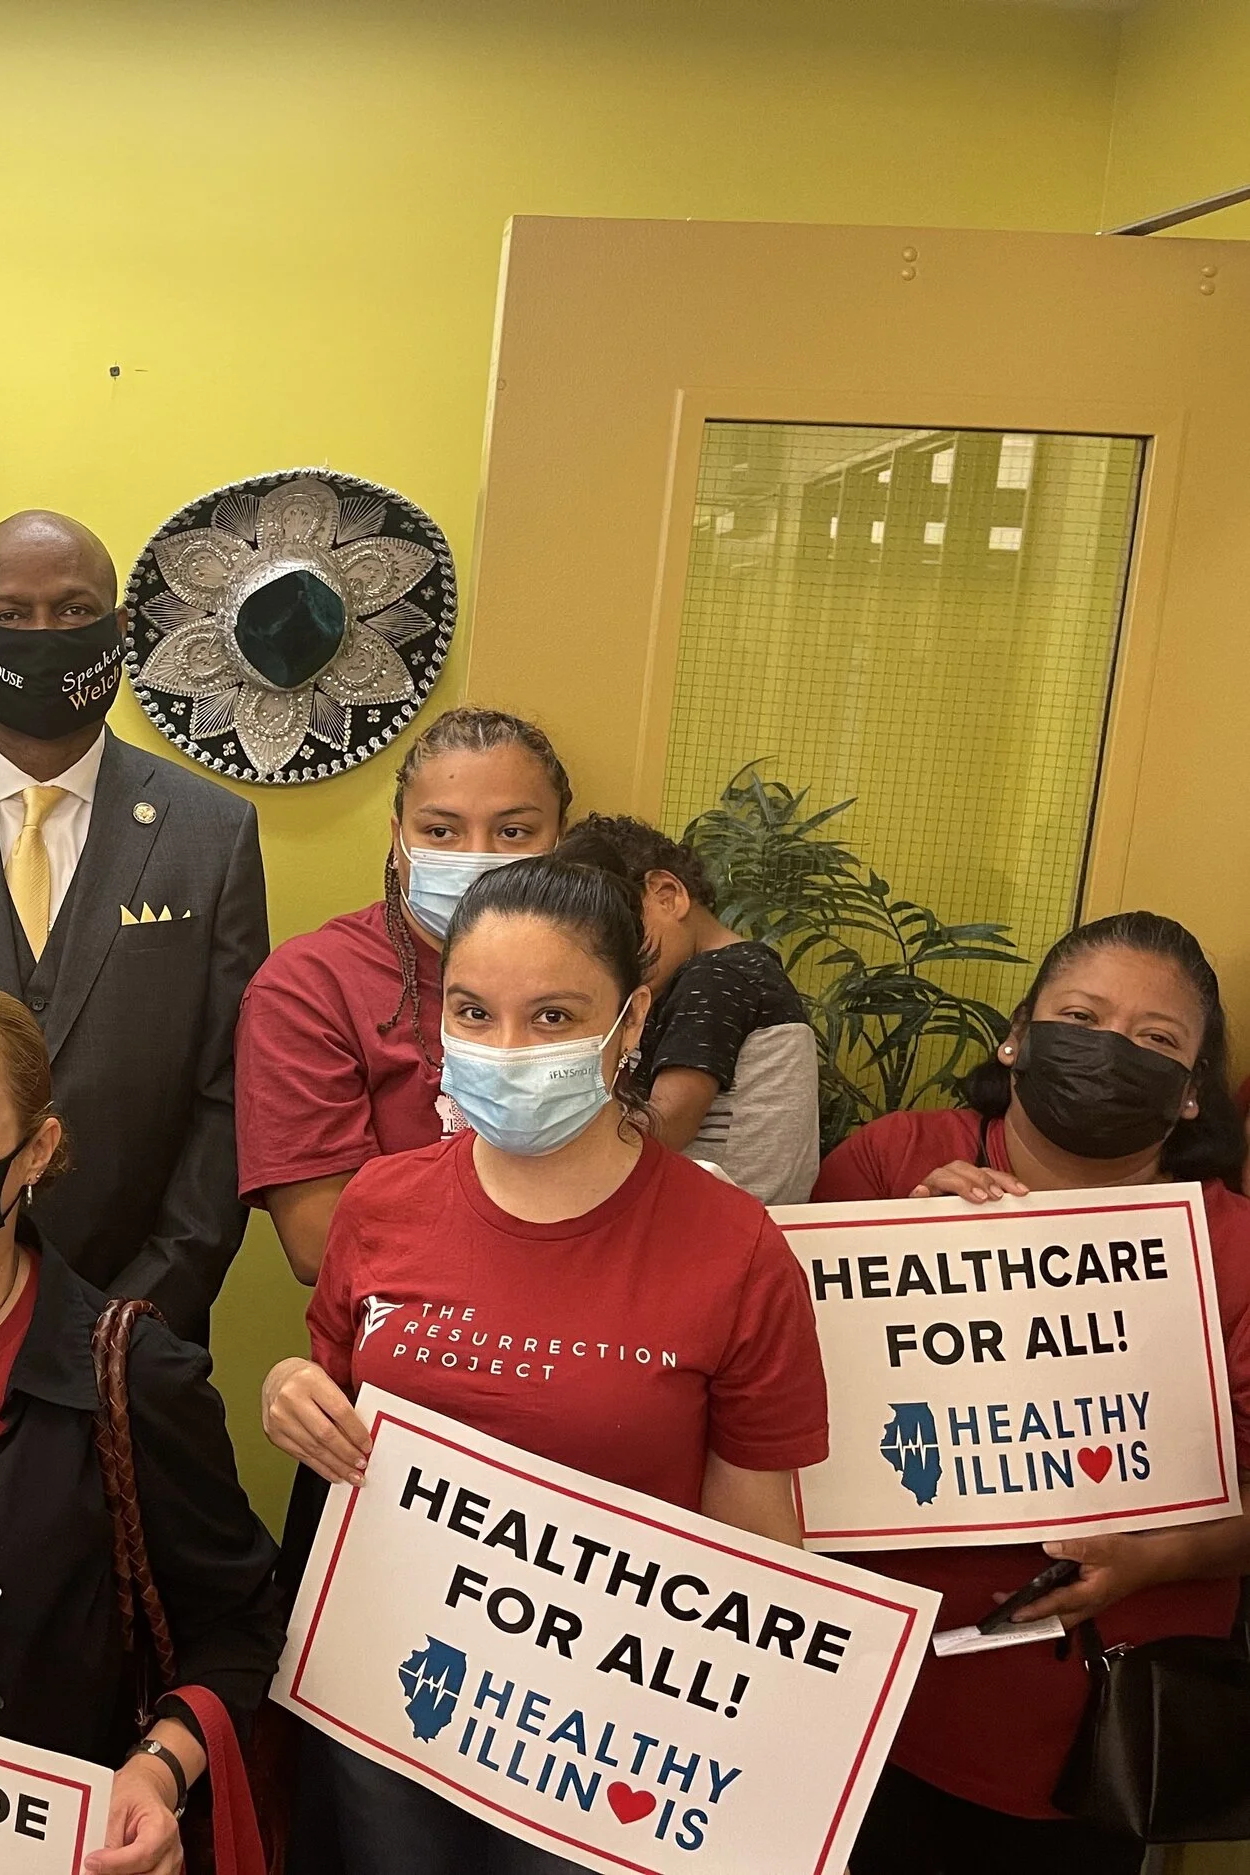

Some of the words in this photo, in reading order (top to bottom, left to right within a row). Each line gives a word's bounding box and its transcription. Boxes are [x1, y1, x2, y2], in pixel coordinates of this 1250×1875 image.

[61, 644, 122, 693] Speaker
[68, 664, 120, 711] Welch
[811, 1238, 1168, 1301] HEALTHCARE
[421, 1302, 476, 1322] THE
[886, 1320, 1007, 1368] FOR
[1025, 1310, 1129, 1360] ALL!
[392, 1343, 556, 1381] PROJECT
[403, 1320, 678, 1369] RESURRECTION
[948, 1391, 1150, 1446] HEALTHY
[399, 1465, 852, 1674] HEALTHCARE
[444, 1564, 583, 1660] FOR
[595, 1633, 751, 1719] ALL!
[473, 1670, 743, 1805] HEALTHY
